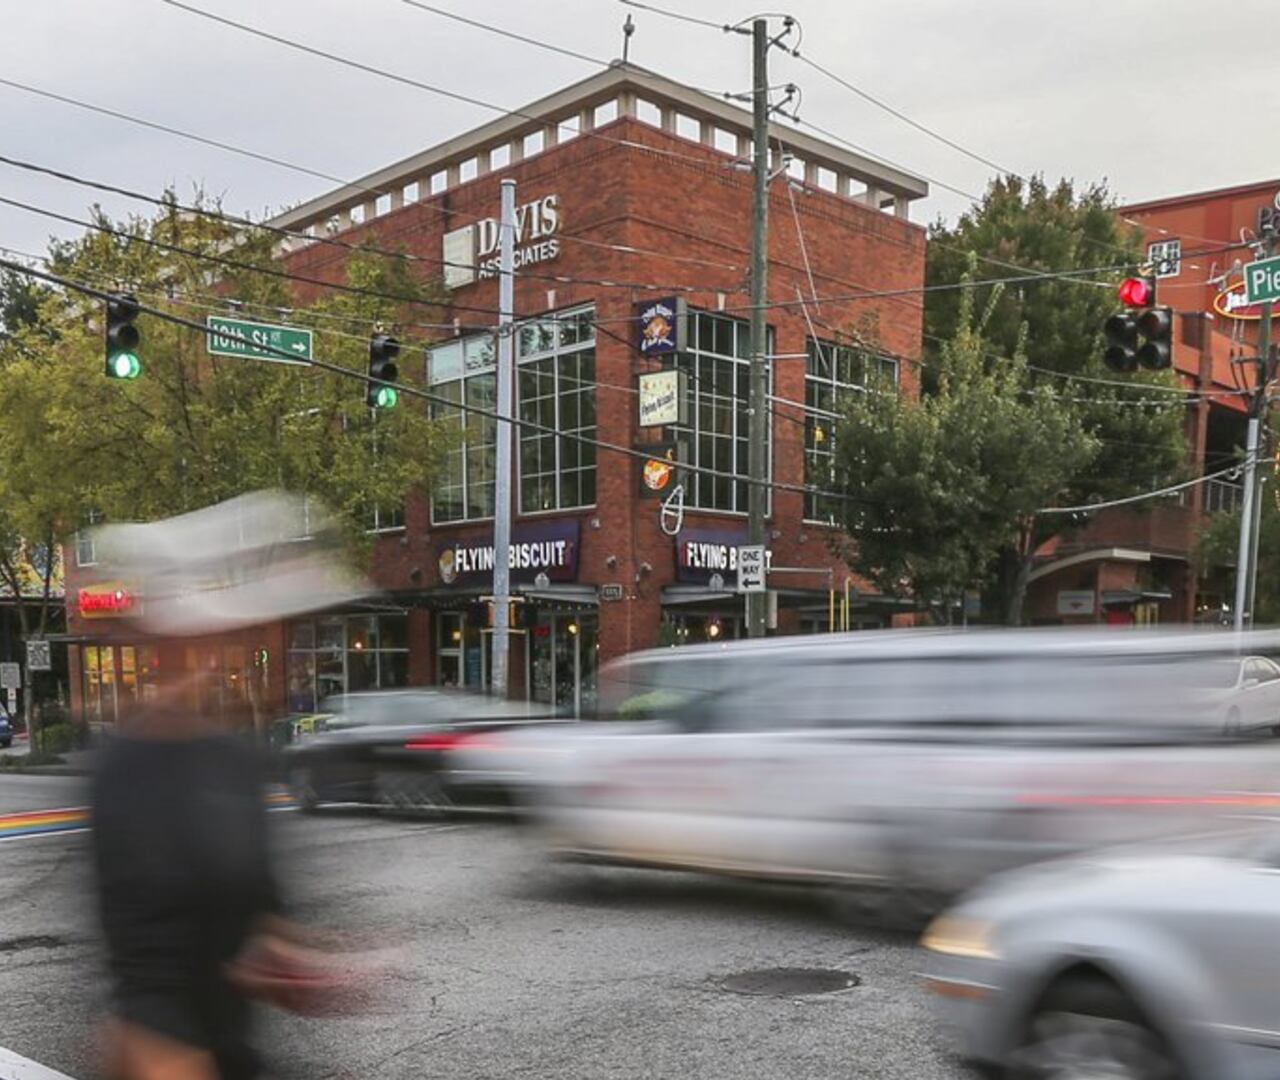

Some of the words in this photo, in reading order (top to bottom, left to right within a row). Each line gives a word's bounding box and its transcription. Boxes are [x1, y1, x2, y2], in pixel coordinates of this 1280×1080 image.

[477, 194, 557, 256] DVIS
[478, 239, 560, 279] ASSCIATES
[213, 323, 246, 350] 10th
[252, 329, 269, 353] St
[455, 546, 497, 573] FLYIN
[508, 540, 566, 569] BISCUIT
[687, 541, 727, 570] FLYING
[741, 550, 760, 562] ONE
[741, 566, 760, 575] WAY
